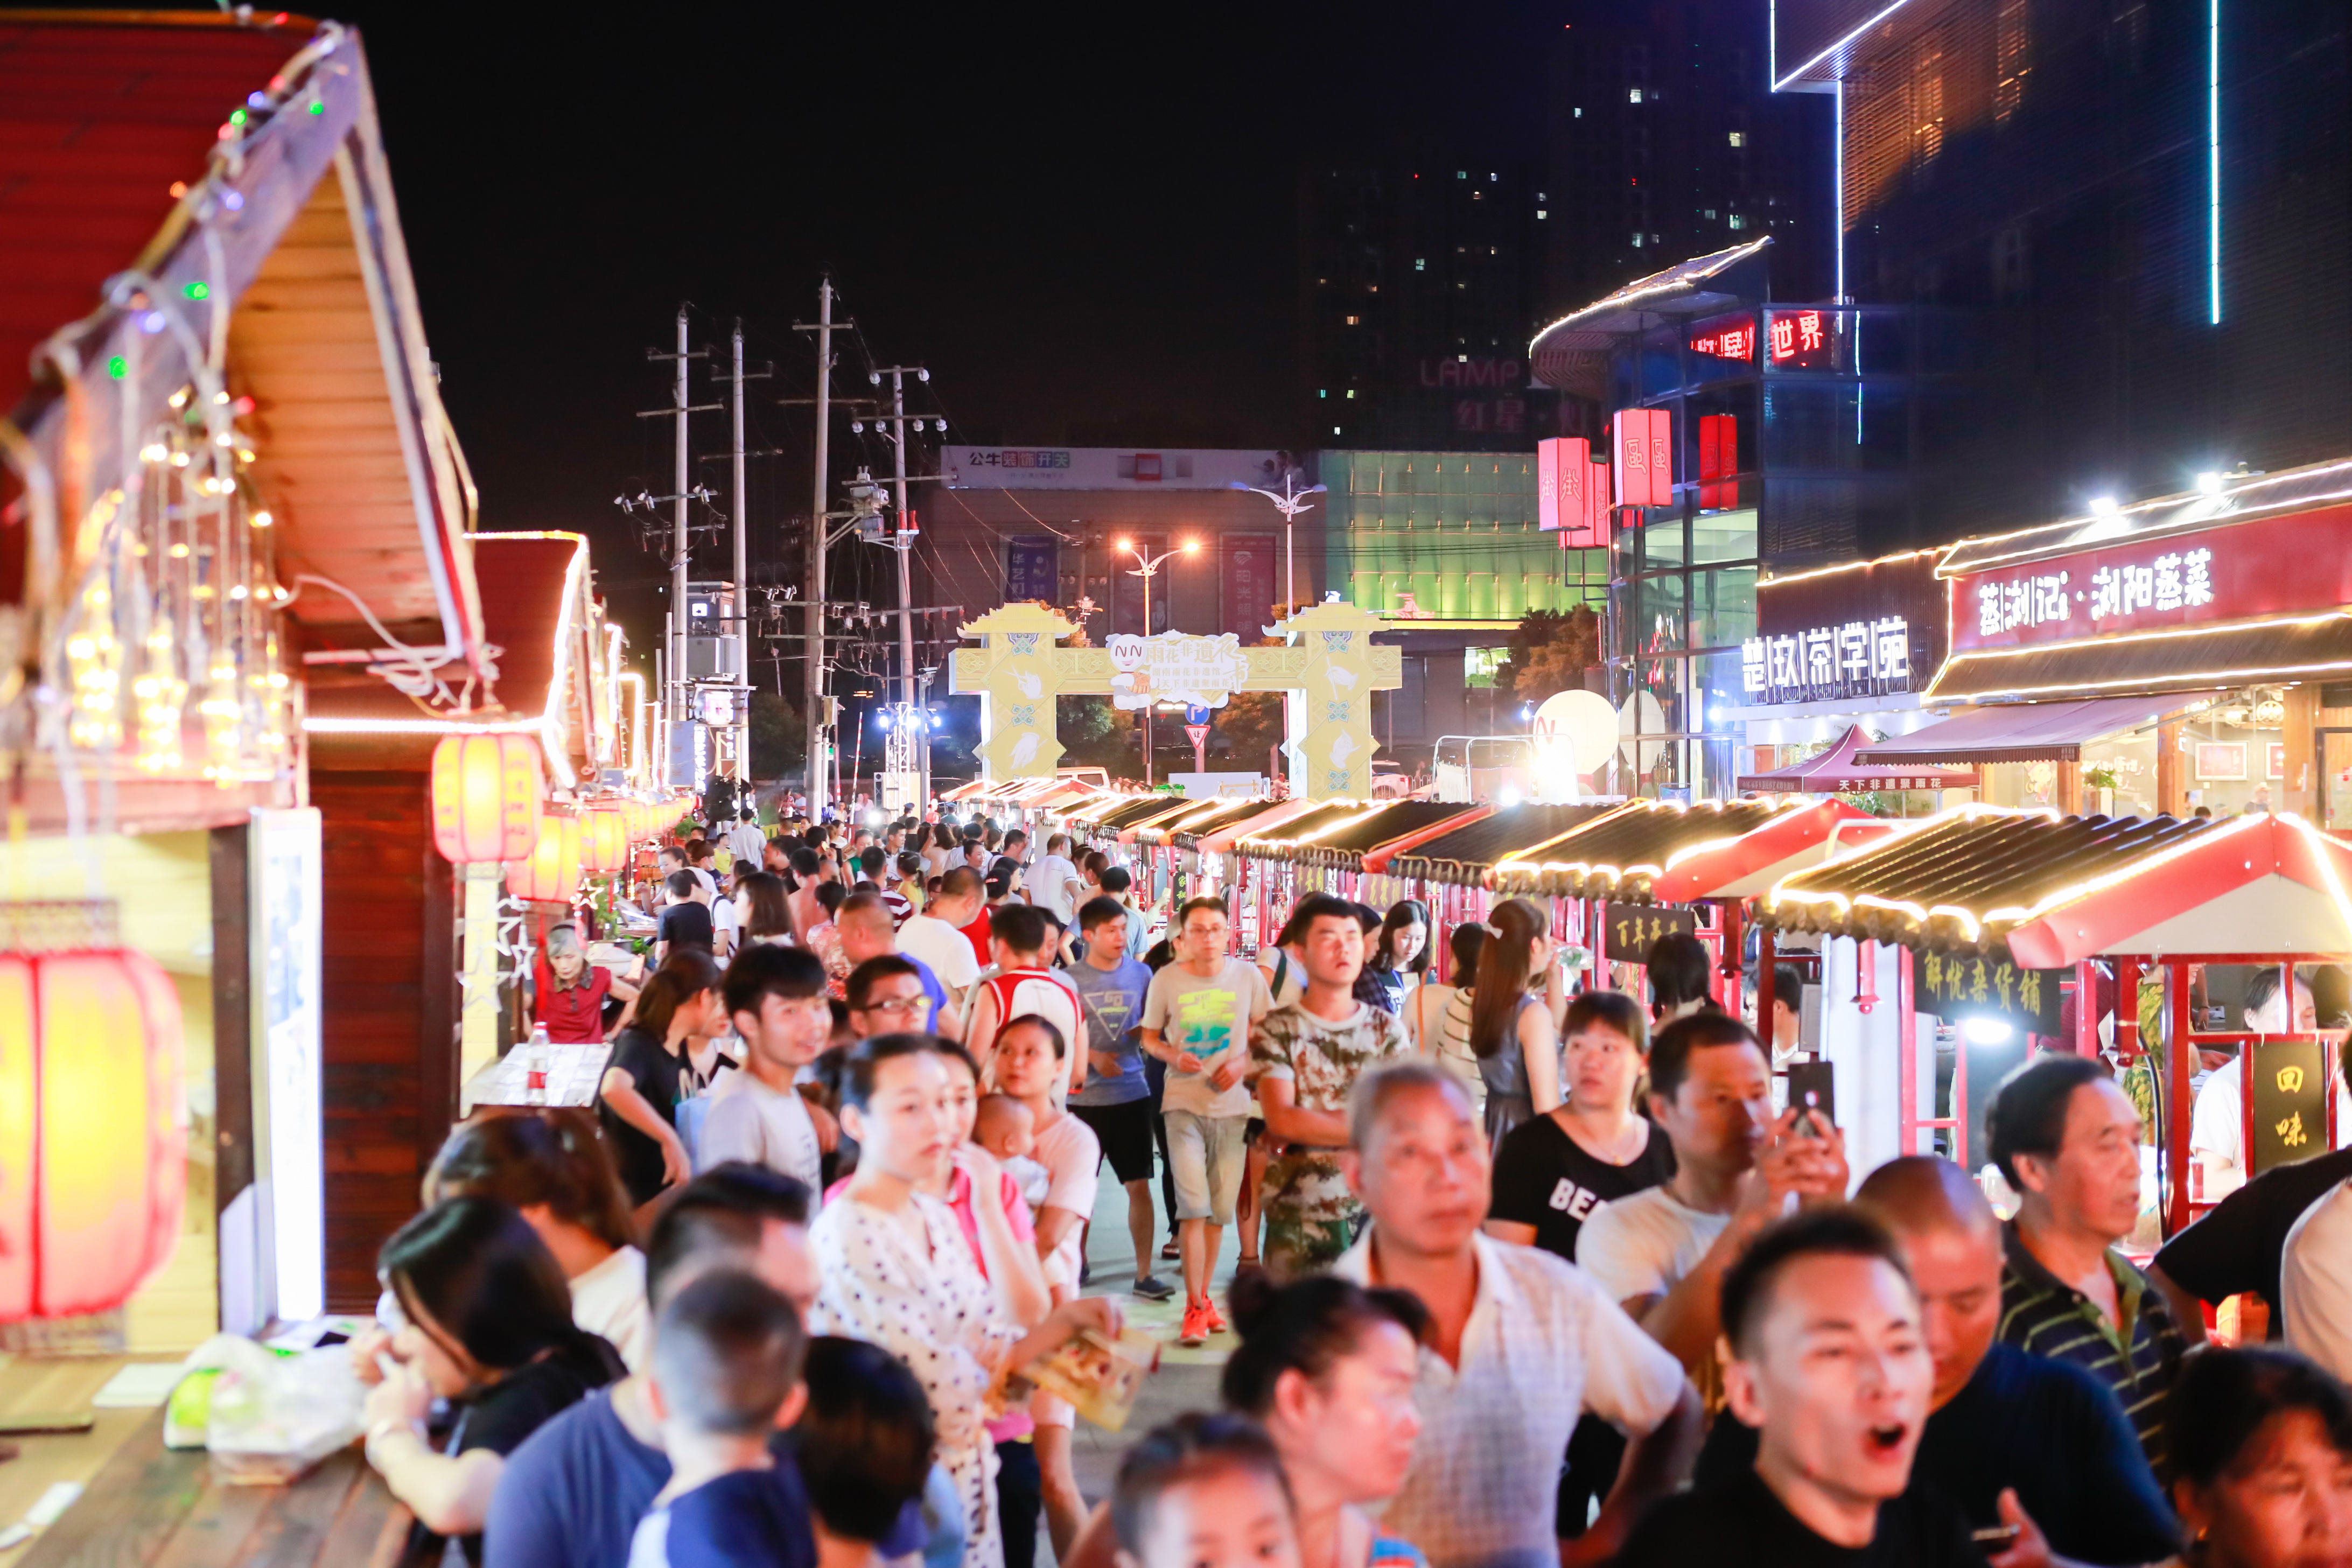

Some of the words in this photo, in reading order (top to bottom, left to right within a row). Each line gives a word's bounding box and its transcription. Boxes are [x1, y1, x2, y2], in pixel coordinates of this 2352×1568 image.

[1419, 360, 1520, 387] LAMP
[970, 451, 1069, 467] 公牛装饰开关
[1839, 778, 1942, 791] 天下非遗聚雨花
[1924, 949, 2041, 1017] 解忧杂货铺
[2275, 1066, 2308, 1146] 回味
